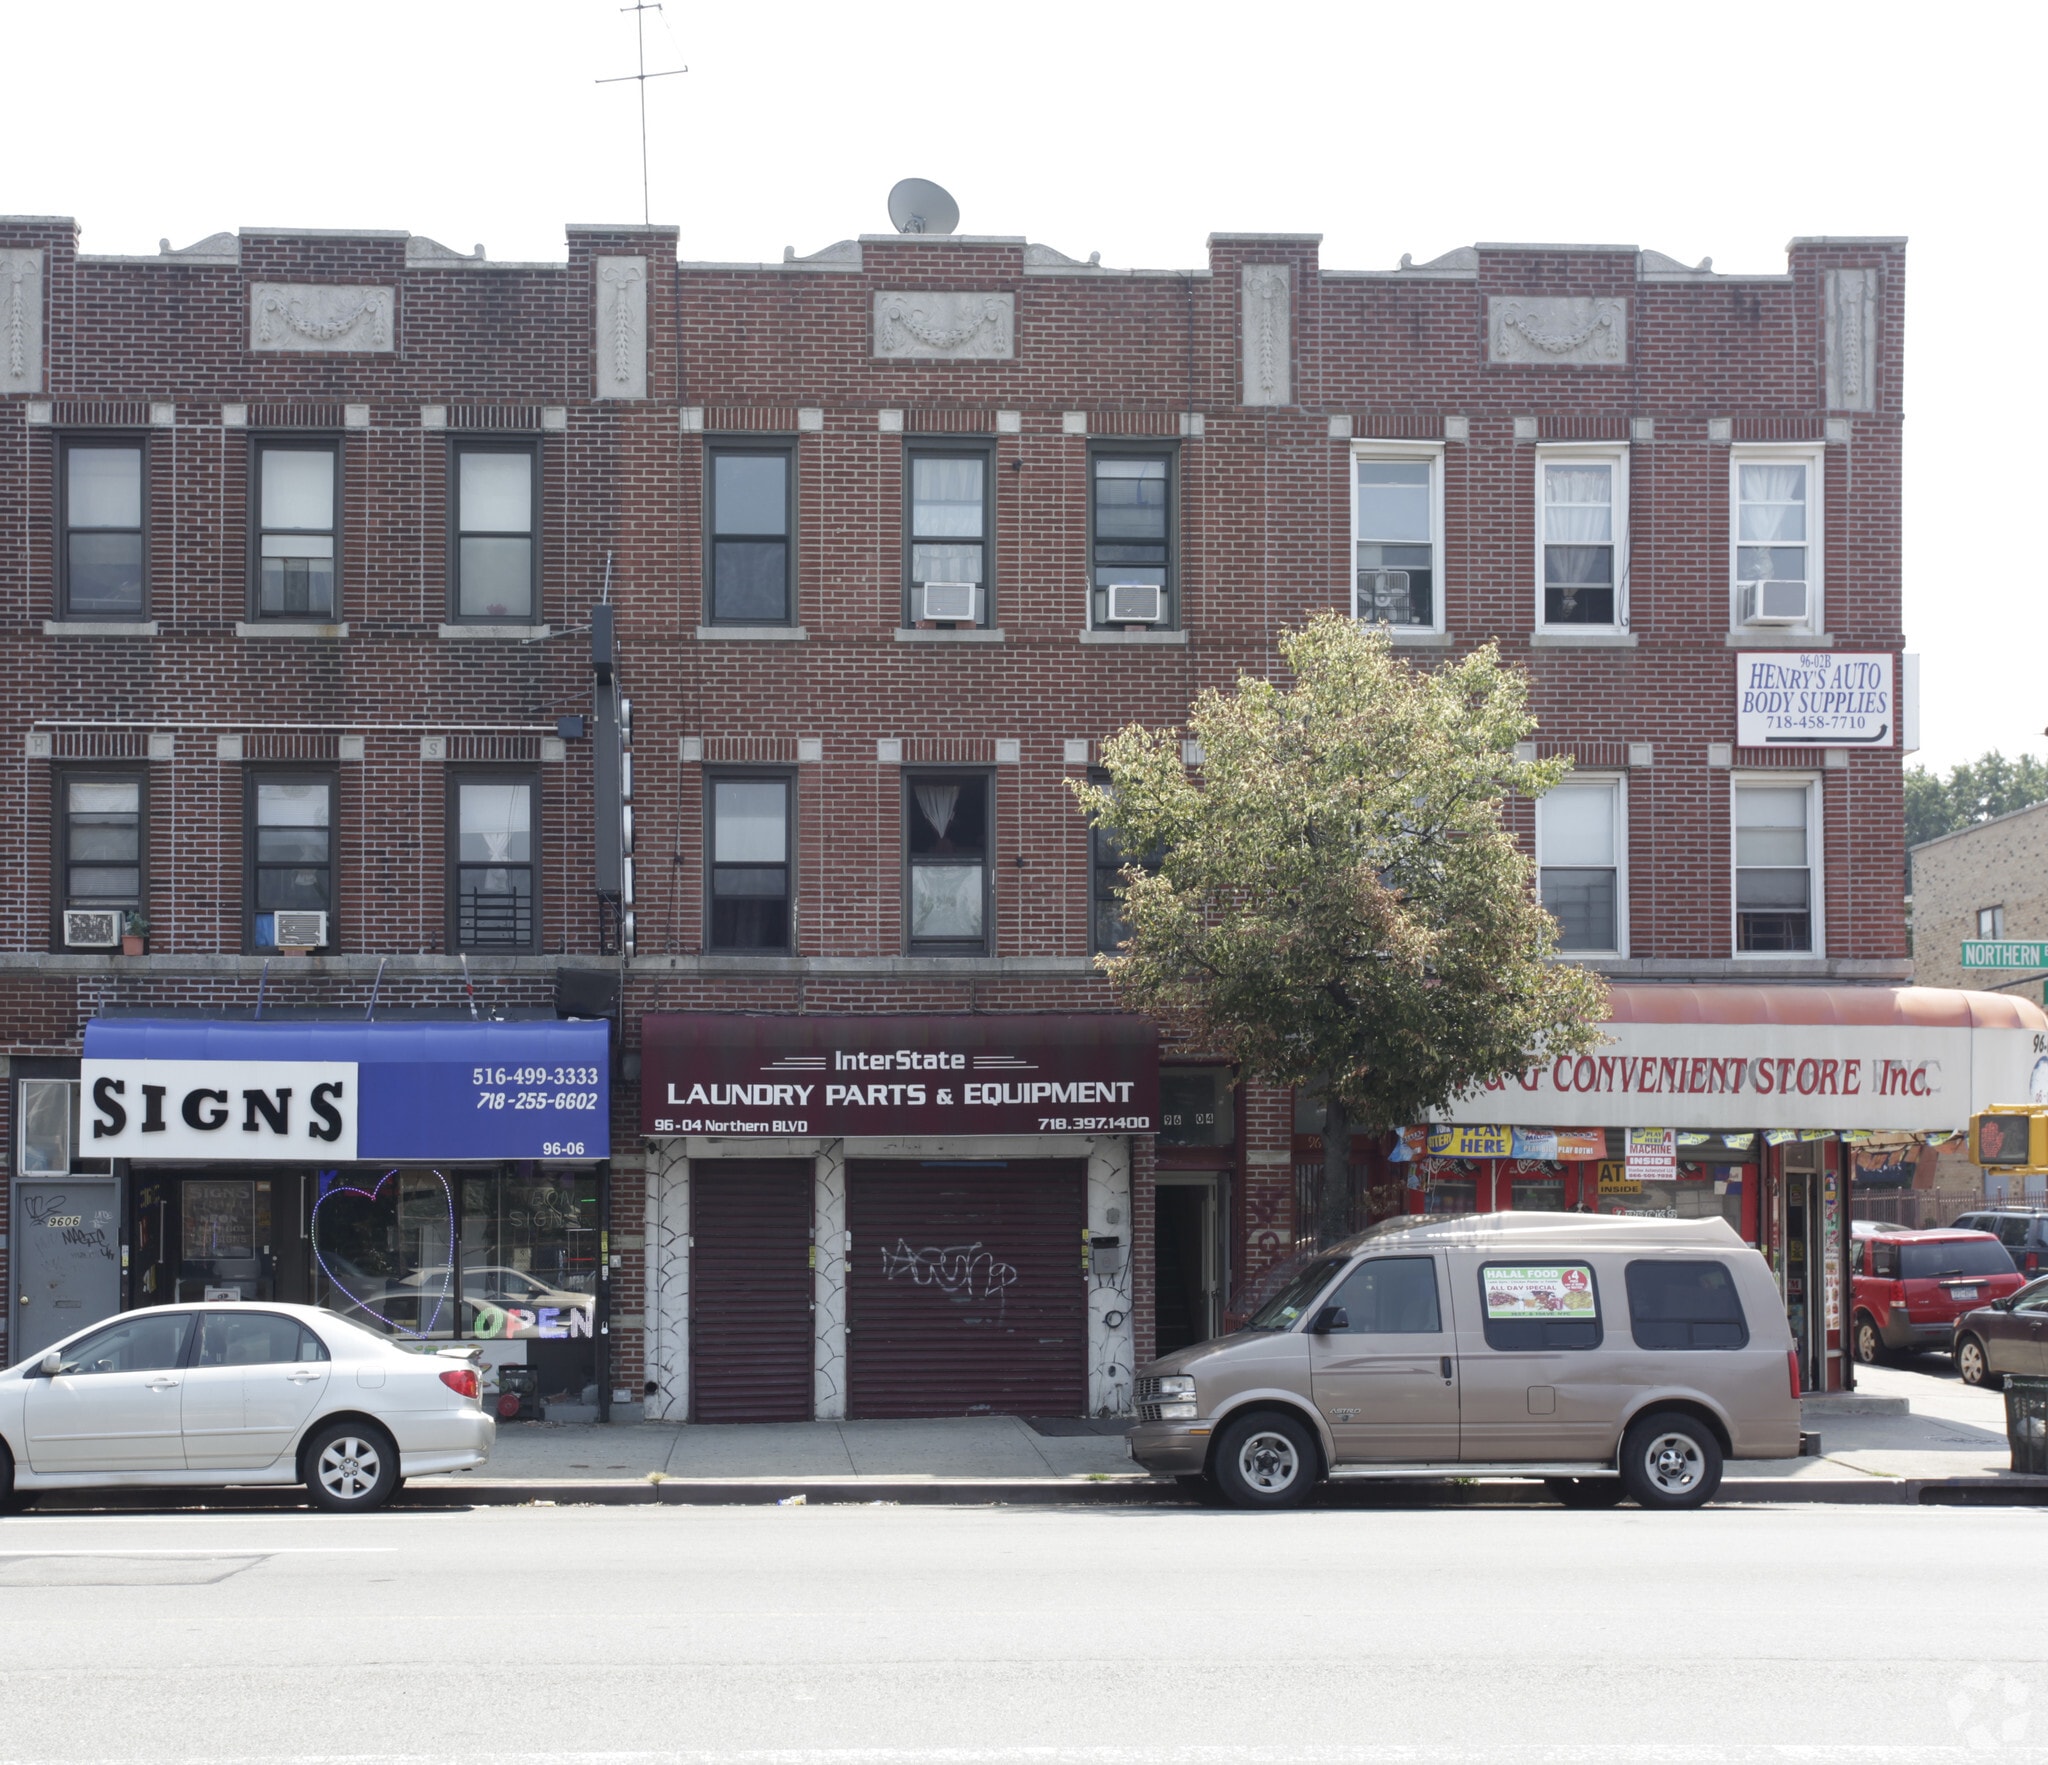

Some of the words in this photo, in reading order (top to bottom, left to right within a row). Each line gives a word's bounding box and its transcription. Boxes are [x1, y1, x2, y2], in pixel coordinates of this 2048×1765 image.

[1800, 655, 1832, 668] 96-02B
[1749, 663, 1826, 689] HENRY'S
[1830, 662, 1881, 689] AUTO
[1742, 691, 1794, 713] BODY
[1798, 691, 1888, 713] SUPPLIES
[1766, 715, 1866, 729] 718-458-7710
[1965, 944, 2040, 966] NORTHERN
[835, 1050, 966, 1070] InterState
[472, 1067, 598, 1085] 516-499-3333
[1553, 1055, 1748, 1094] CONVENIENT
[1755, 1057, 1862, 1095] STORE
[1879, 1058, 1933, 1096] Inc.
[667, 1083, 815, 1106] LAUNDRY
[825, 1084, 926, 1106] PARTS
[936, 1088, 954, 1105] &
[963, 1081, 1135, 1106] EQUIPMENT
[477, 1092, 598, 1110] 718-255-6602
[93, 1077, 343, 1142] SIGNS
[654, 1119, 703, 1131] 96-04
[705, 1119, 769, 1132] Northern
[772, 1120, 808, 1132] BLVD
[1037, 1116, 1150, 1131] 718.397.1400
[1163, 1114, 1182, 1126] 96
[1196, 1112, 1214, 1125] 04
[1463, 1126, 1502, 1137] PLAY
[542, 1142, 585, 1155] 96-06
[1460, 1138, 1506, 1153] HERE
[1557, 1146, 1574, 1154] PLAY
[1629, 1144, 1672, 1154] MACHINE
[1629, 1156, 1672, 1166] INSIDE
[1600, 1186, 1639, 1195] INSIDE
[49, 1218, 80, 1227] 9606
[1487, 1270, 1525, 1279] HALAL
[1527, 1270, 1559, 1278] FOOD
[474, 1302, 594, 1339] OPEN
